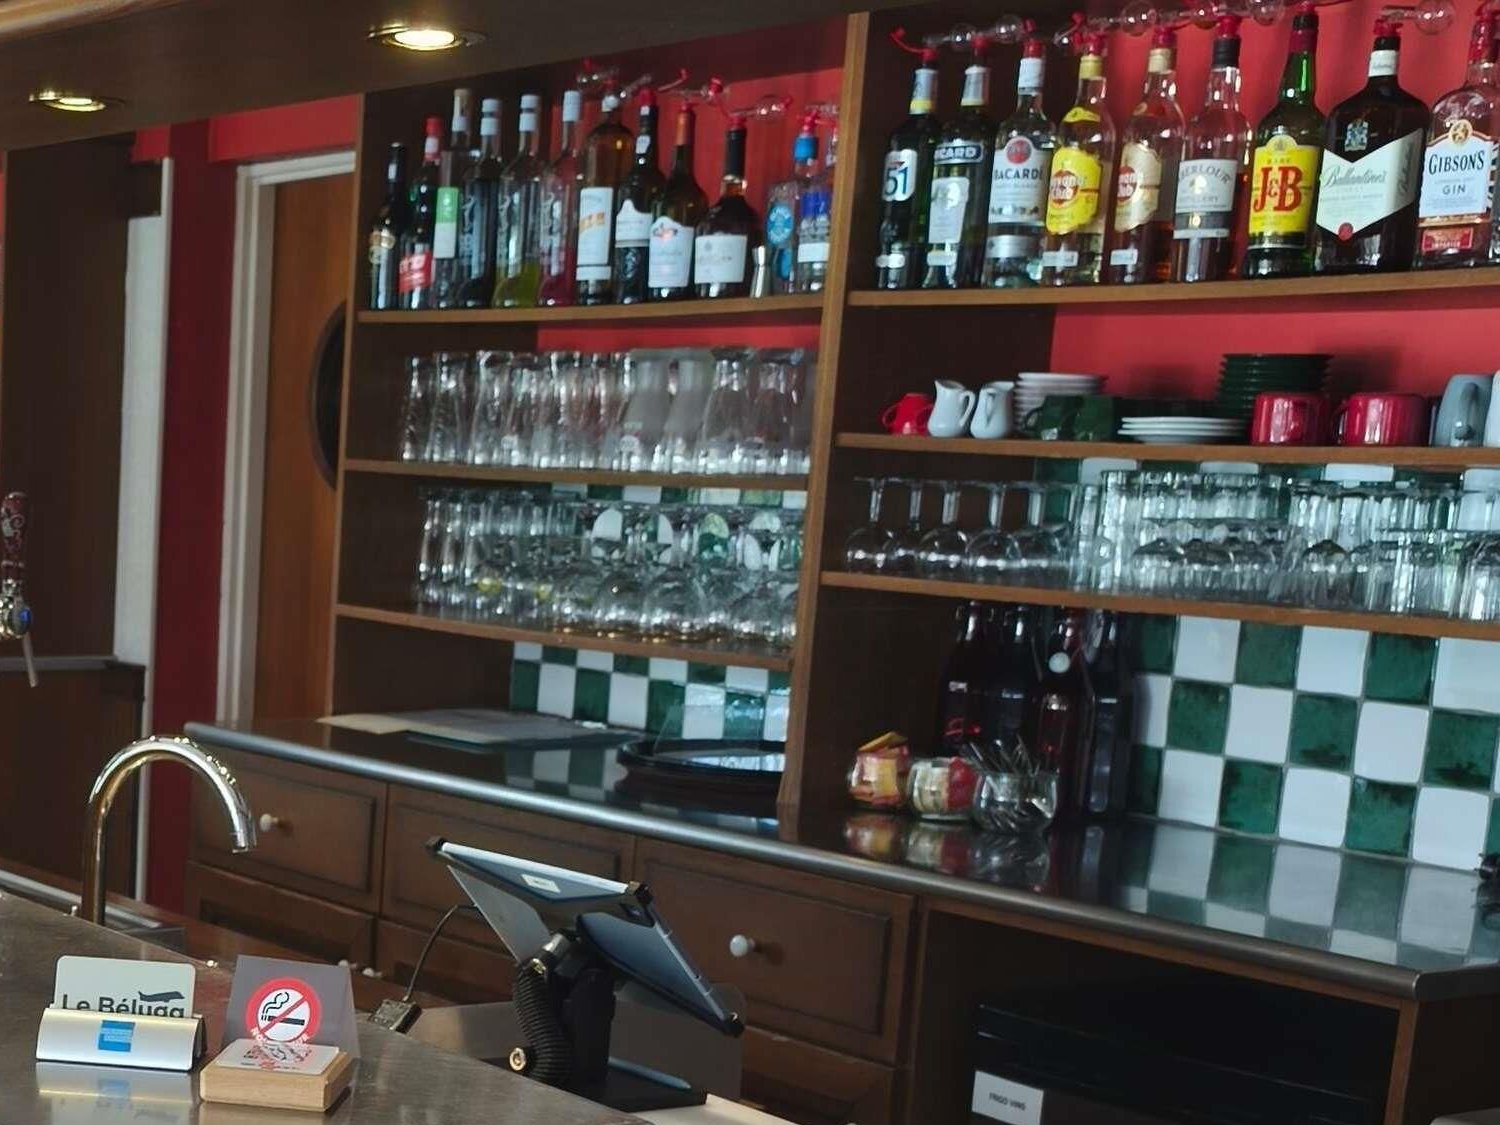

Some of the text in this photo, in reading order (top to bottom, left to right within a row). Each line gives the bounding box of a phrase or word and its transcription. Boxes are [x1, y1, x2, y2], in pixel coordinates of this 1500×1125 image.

[884, 166, 909, 196] 51
[1442, 184, 1466, 196] GIN
[62, 993, 91, 1010] Le
